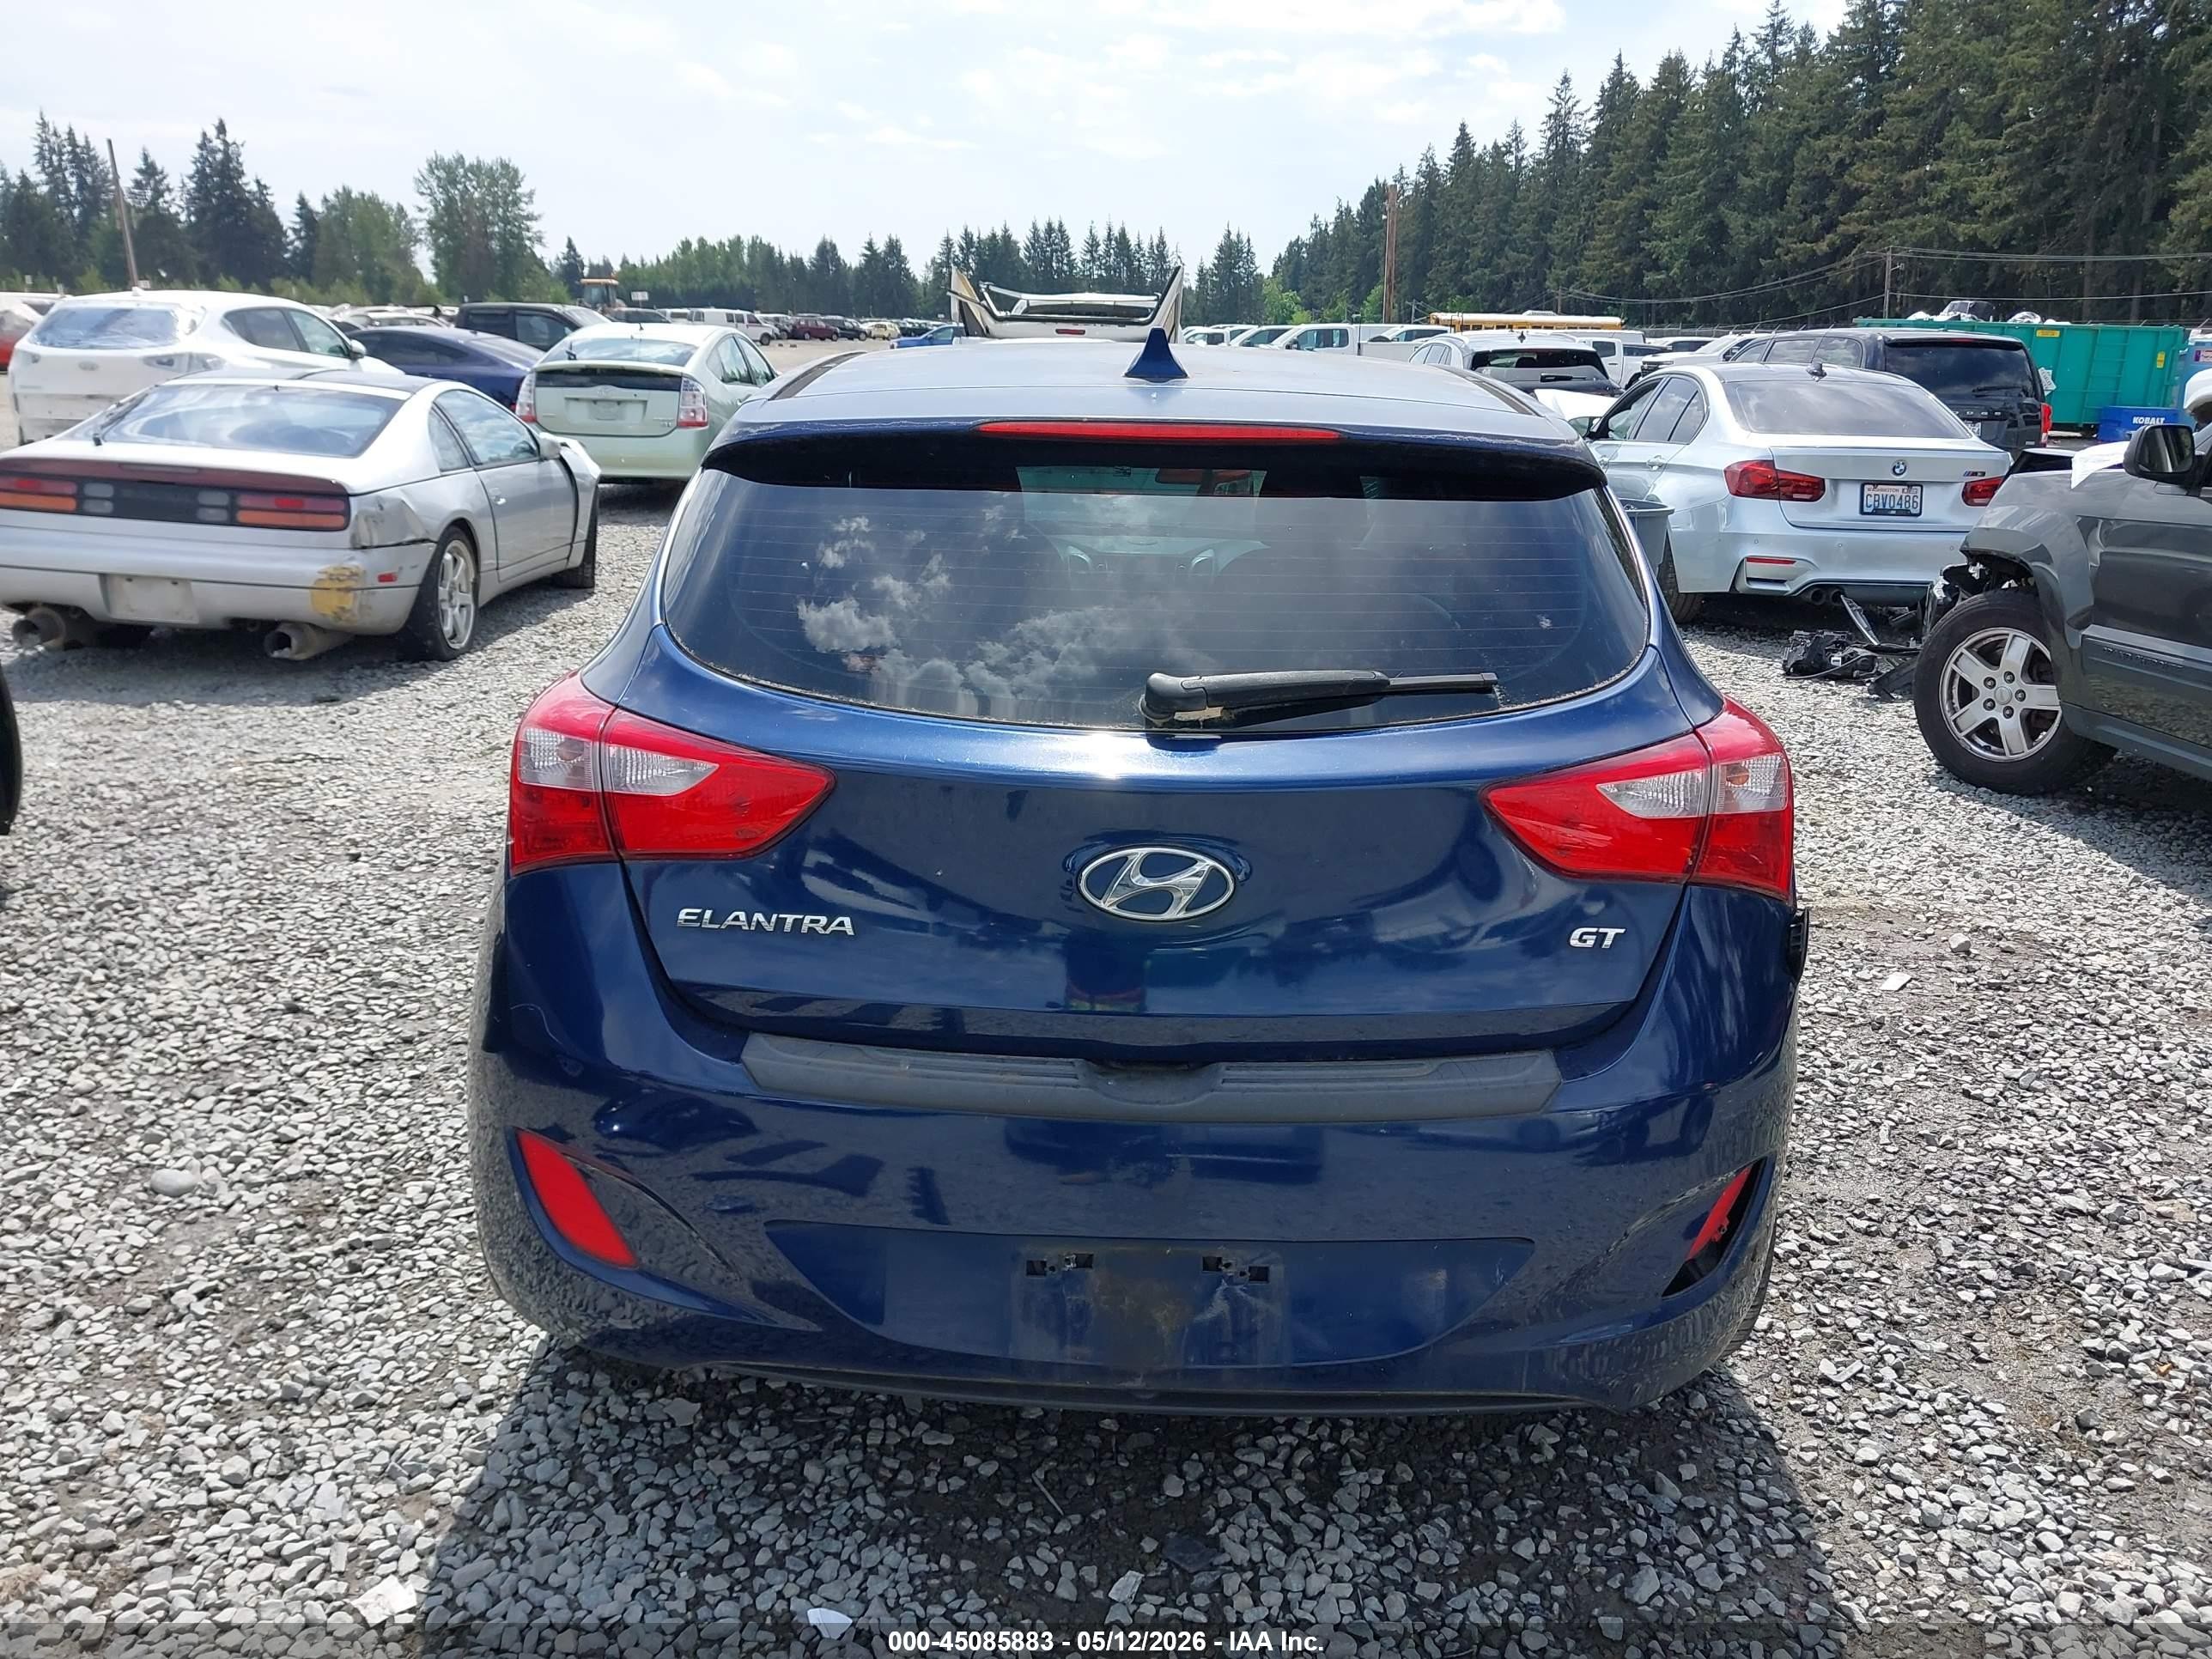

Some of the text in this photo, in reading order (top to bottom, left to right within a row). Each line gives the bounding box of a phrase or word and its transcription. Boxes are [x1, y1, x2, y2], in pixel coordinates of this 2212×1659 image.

[2132, 416, 2166, 425] KOBALT
[1865, 494, 1919, 509] CBV0486
[678, 908, 854, 936] ELANTRA
[1569, 927, 1626, 949] GT
